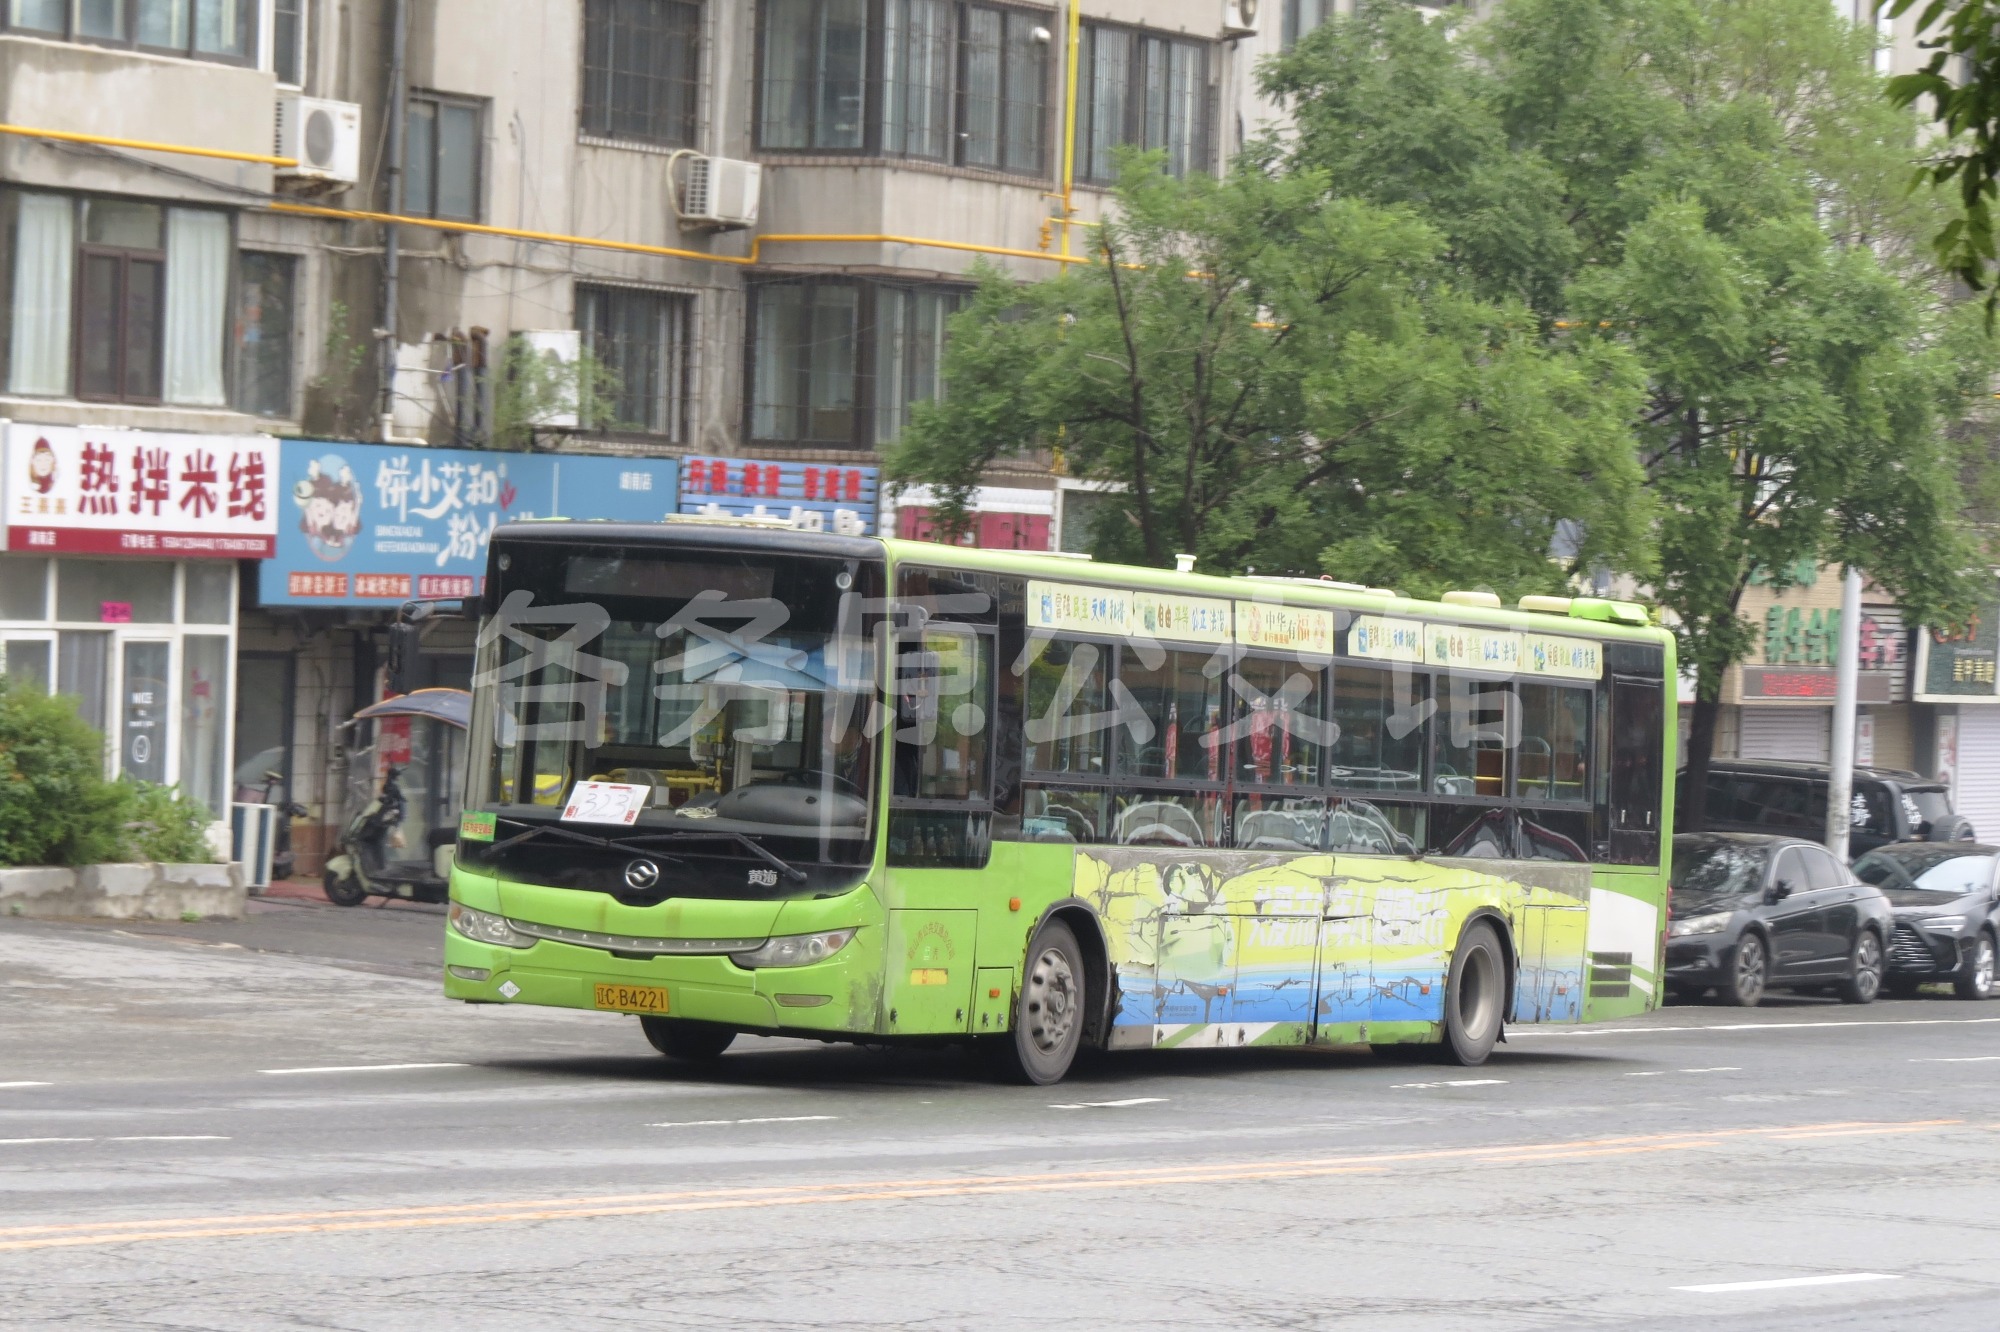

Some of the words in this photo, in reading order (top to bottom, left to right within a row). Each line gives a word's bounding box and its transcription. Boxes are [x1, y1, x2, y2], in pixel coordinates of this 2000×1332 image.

[78, 441, 266, 521] 热拌米线
[578, 793, 630, 818] 323
[748, 869, 778, 887] 黄海
